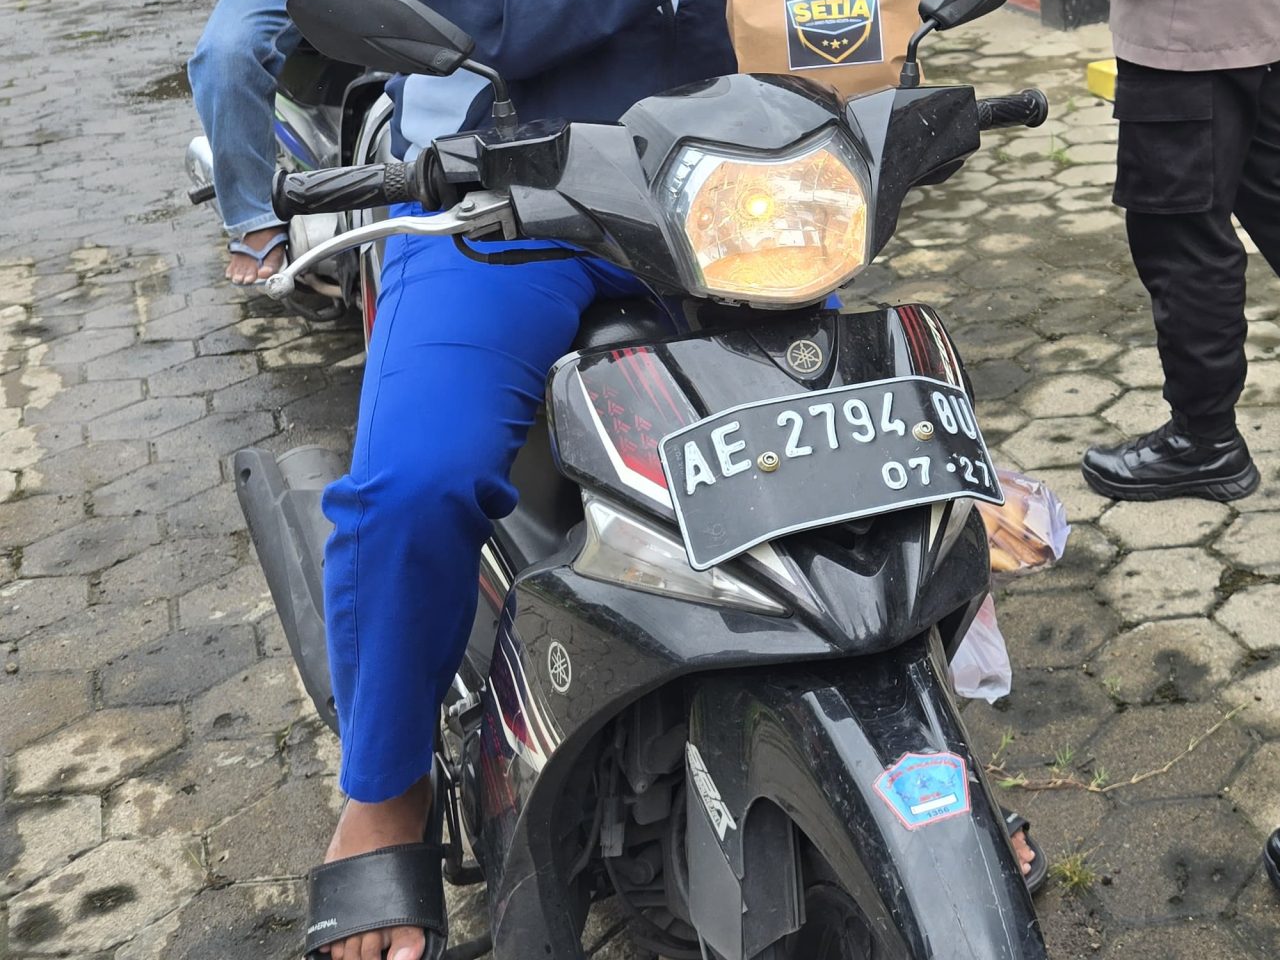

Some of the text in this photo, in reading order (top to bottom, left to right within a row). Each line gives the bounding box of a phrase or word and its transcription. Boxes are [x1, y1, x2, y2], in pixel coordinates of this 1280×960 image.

[684, 421, 751, 495] AE
[777, 392, 906, 458] 2794
[881, 456, 991, 490] 07 27
